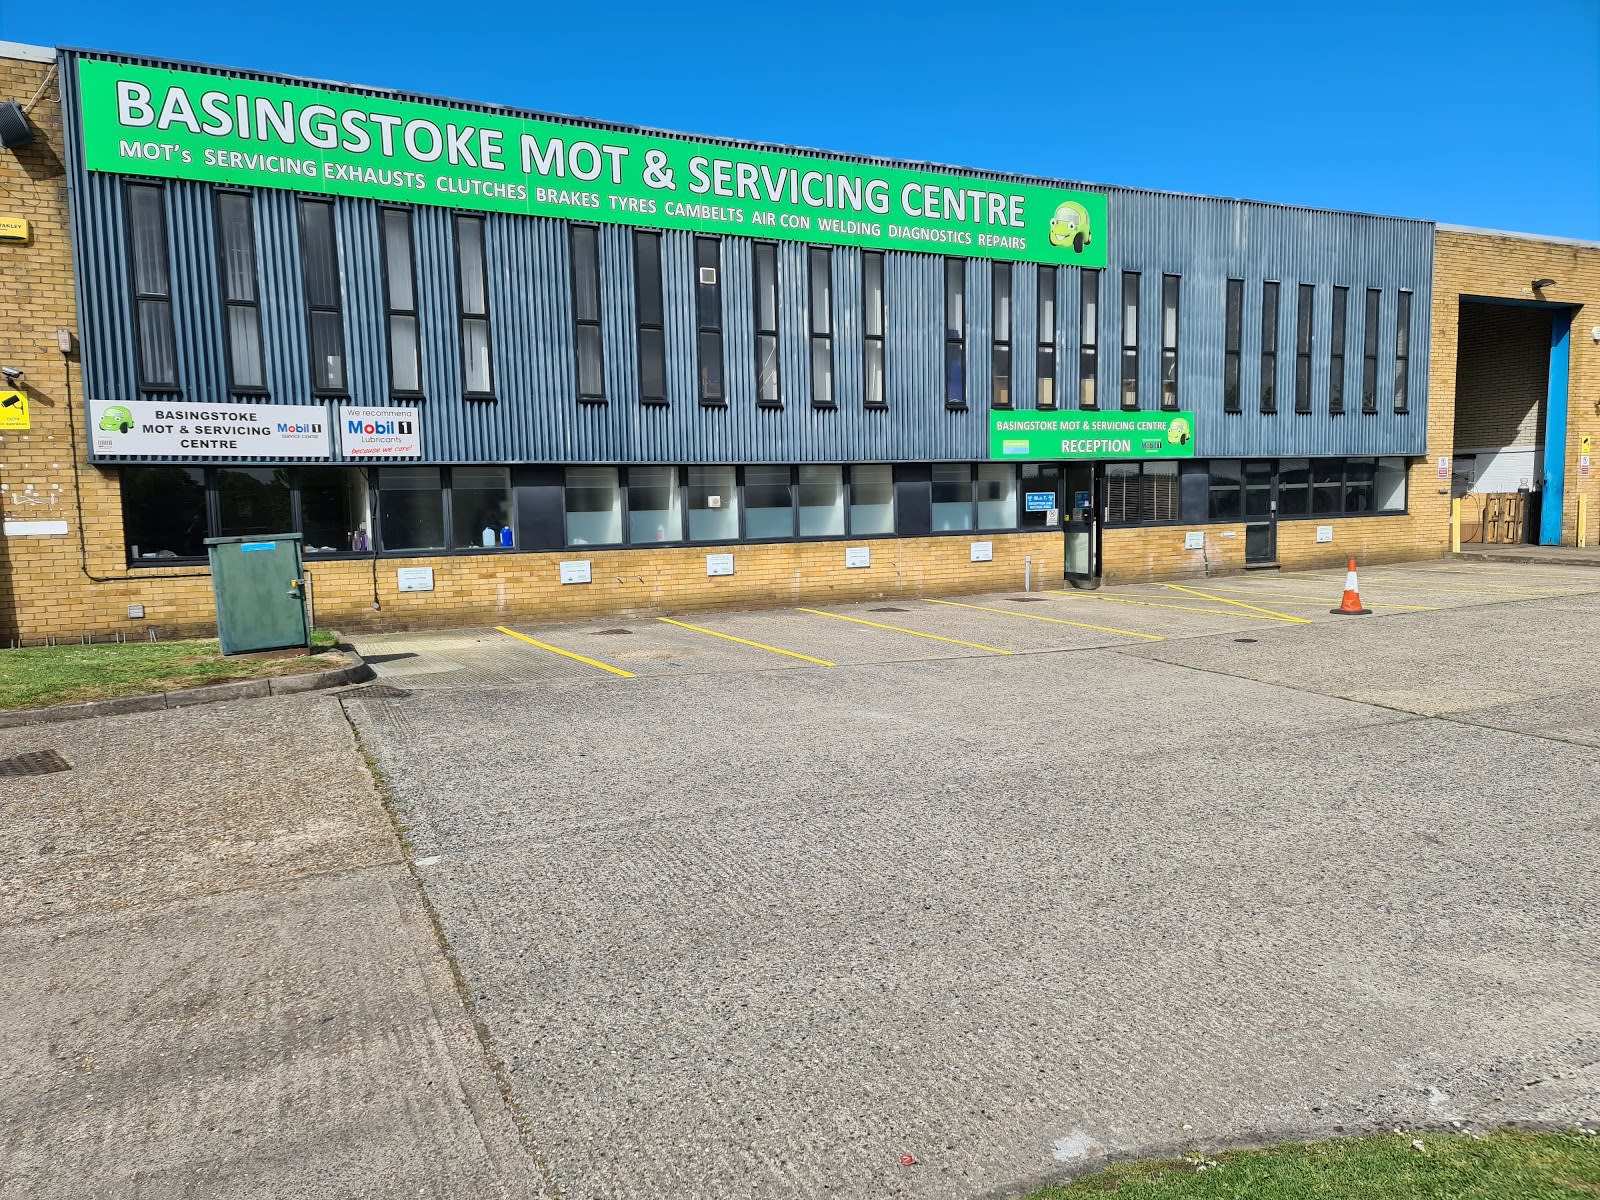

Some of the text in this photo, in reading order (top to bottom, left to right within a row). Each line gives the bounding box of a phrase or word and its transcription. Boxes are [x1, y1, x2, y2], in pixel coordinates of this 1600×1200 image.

[115, 80, 1025, 228] BASINGSTOKE MOT & SERVICING CENTRE
[119, 140, 1026, 250] MOT's SERVICING EXHAUSTS CLUTCHES BRAKES TYRES CAMBELTS AIR CON WELDING DIAGNOSTICS REPAIRS
[155, 410, 257, 422] BASINGSTOKE
[142, 424, 271, 436] MOT & SERVICING
[277, 423, 321, 433] Mobil 1
[348, 420, 412, 435] Mobil 1
[996, 421, 1167, 431] BASINGSTOKE MOT & SERVICING CENTRE
[180, 439, 237, 449] CENTRE
[1061, 439, 1131, 453] RECEPTION
